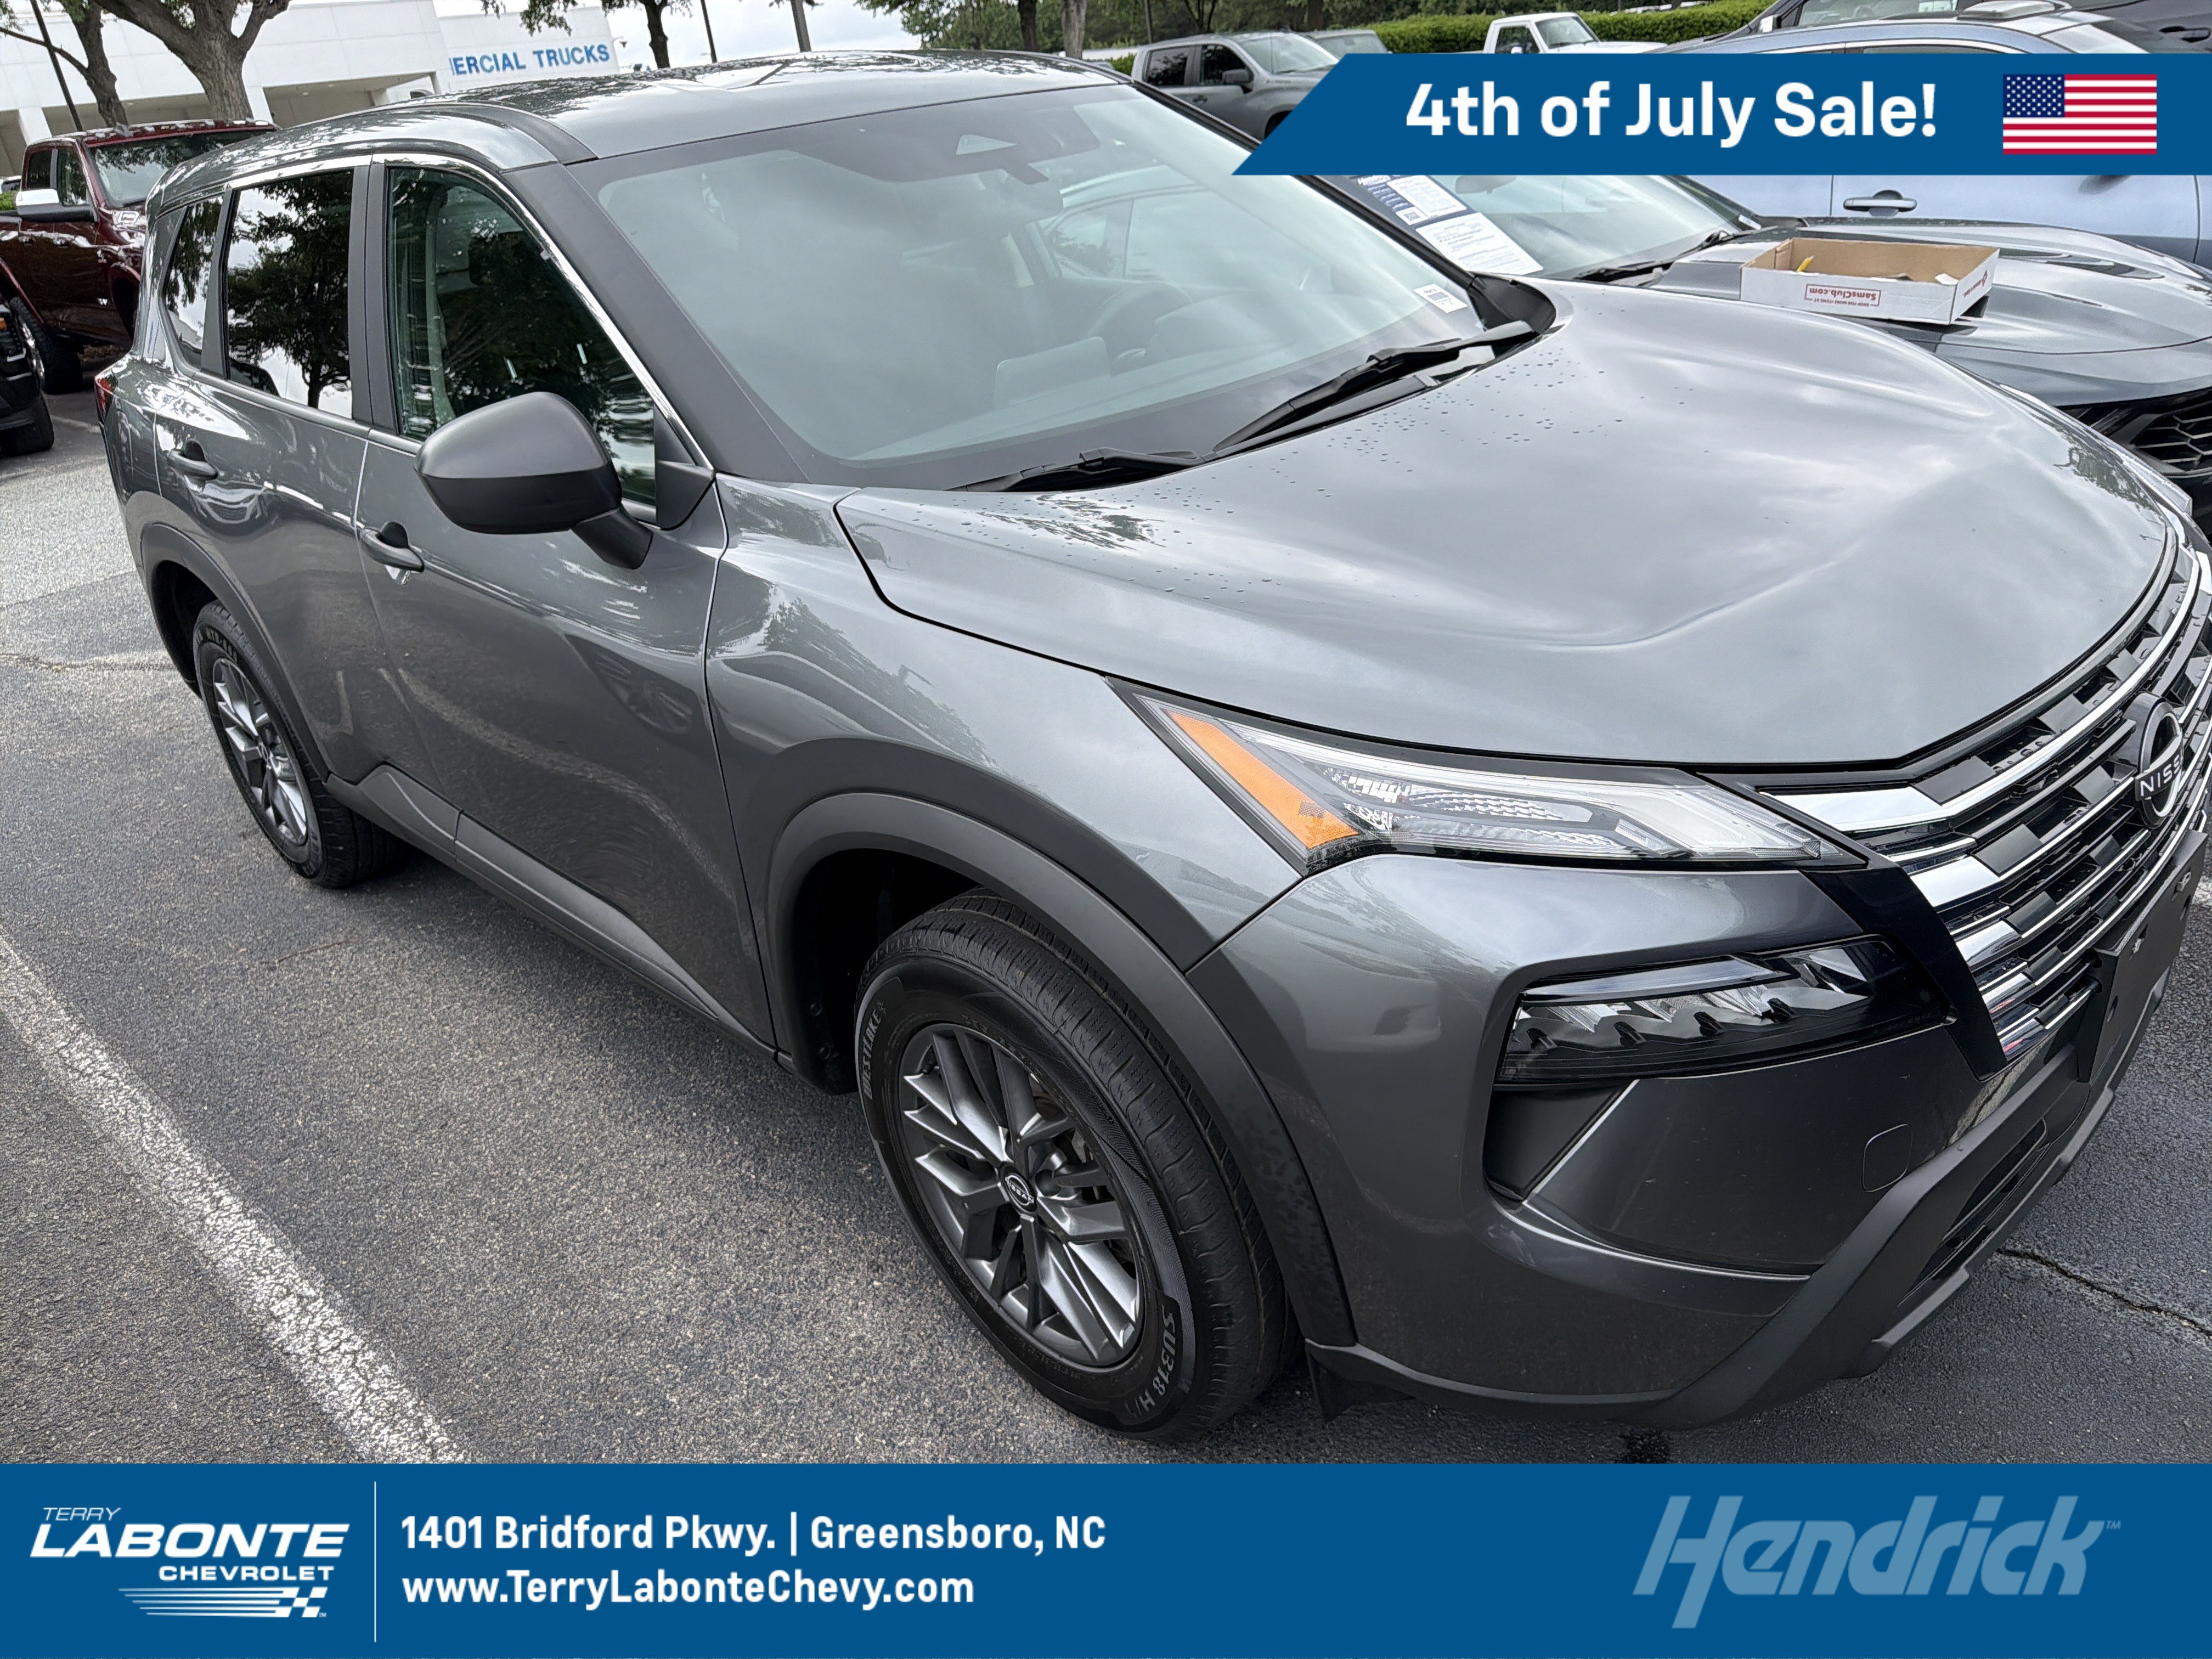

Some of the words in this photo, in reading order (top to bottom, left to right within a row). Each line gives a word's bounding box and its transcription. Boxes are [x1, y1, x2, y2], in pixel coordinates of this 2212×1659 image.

[449, 52, 526, 76] ERCIAL
[532, 43, 610, 68] TRUCKS
[1809, 287, 1876, 301] SamsClub.com
[862, 1008, 882, 1100] WESTLAKE
